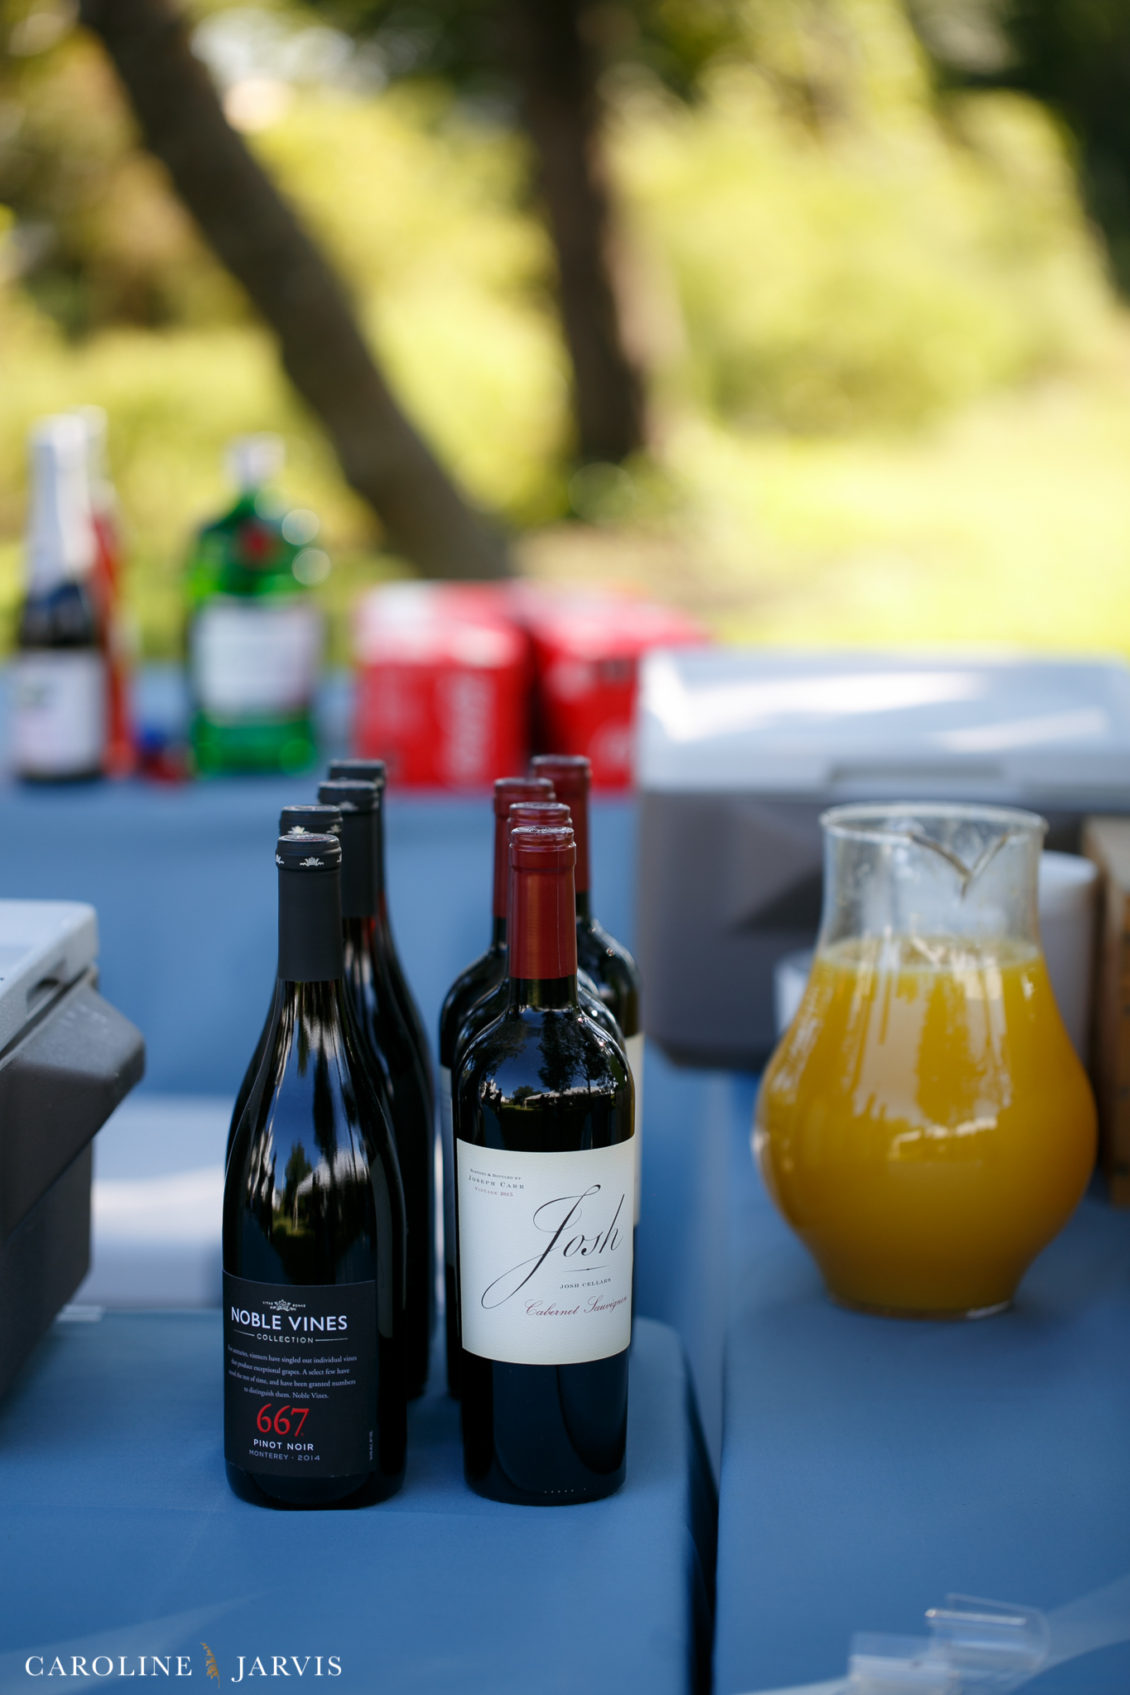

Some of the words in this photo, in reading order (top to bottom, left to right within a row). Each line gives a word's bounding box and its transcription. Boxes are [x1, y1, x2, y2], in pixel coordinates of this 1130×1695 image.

[468, 1175, 496, 1186] JOSEPH
[500, 1181, 524, 1189] CARR
[481, 1184, 624, 1309] Josh
[582, 1277, 612, 1287] CELLARS
[525, 1298, 580, 1316] Cabernet
[231, 1306, 282, 1330] NOBLE
[288, 1315, 348, 1331] VINES
[256, 1333, 314, 1344] COLLECTION
[313, 1355, 342, 1364] individual
[308, 1368, 324, 1376] select
[325, 1367, 336, 1375] few
[336, 1367, 350, 1375] have
[269, 1378, 279, 1386] and
[280, 1378, 293, 1387] have
[293, 1379, 307, 1387] been
[308, 1379, 331, 1389] granted
[292, 1391, 310, 1399] Noble
[253, 1438, 282, 1450] PINOT
[287, 1442, 314, 1451] NOIR
[249, 1449, 289, 1460] MONTEREY
